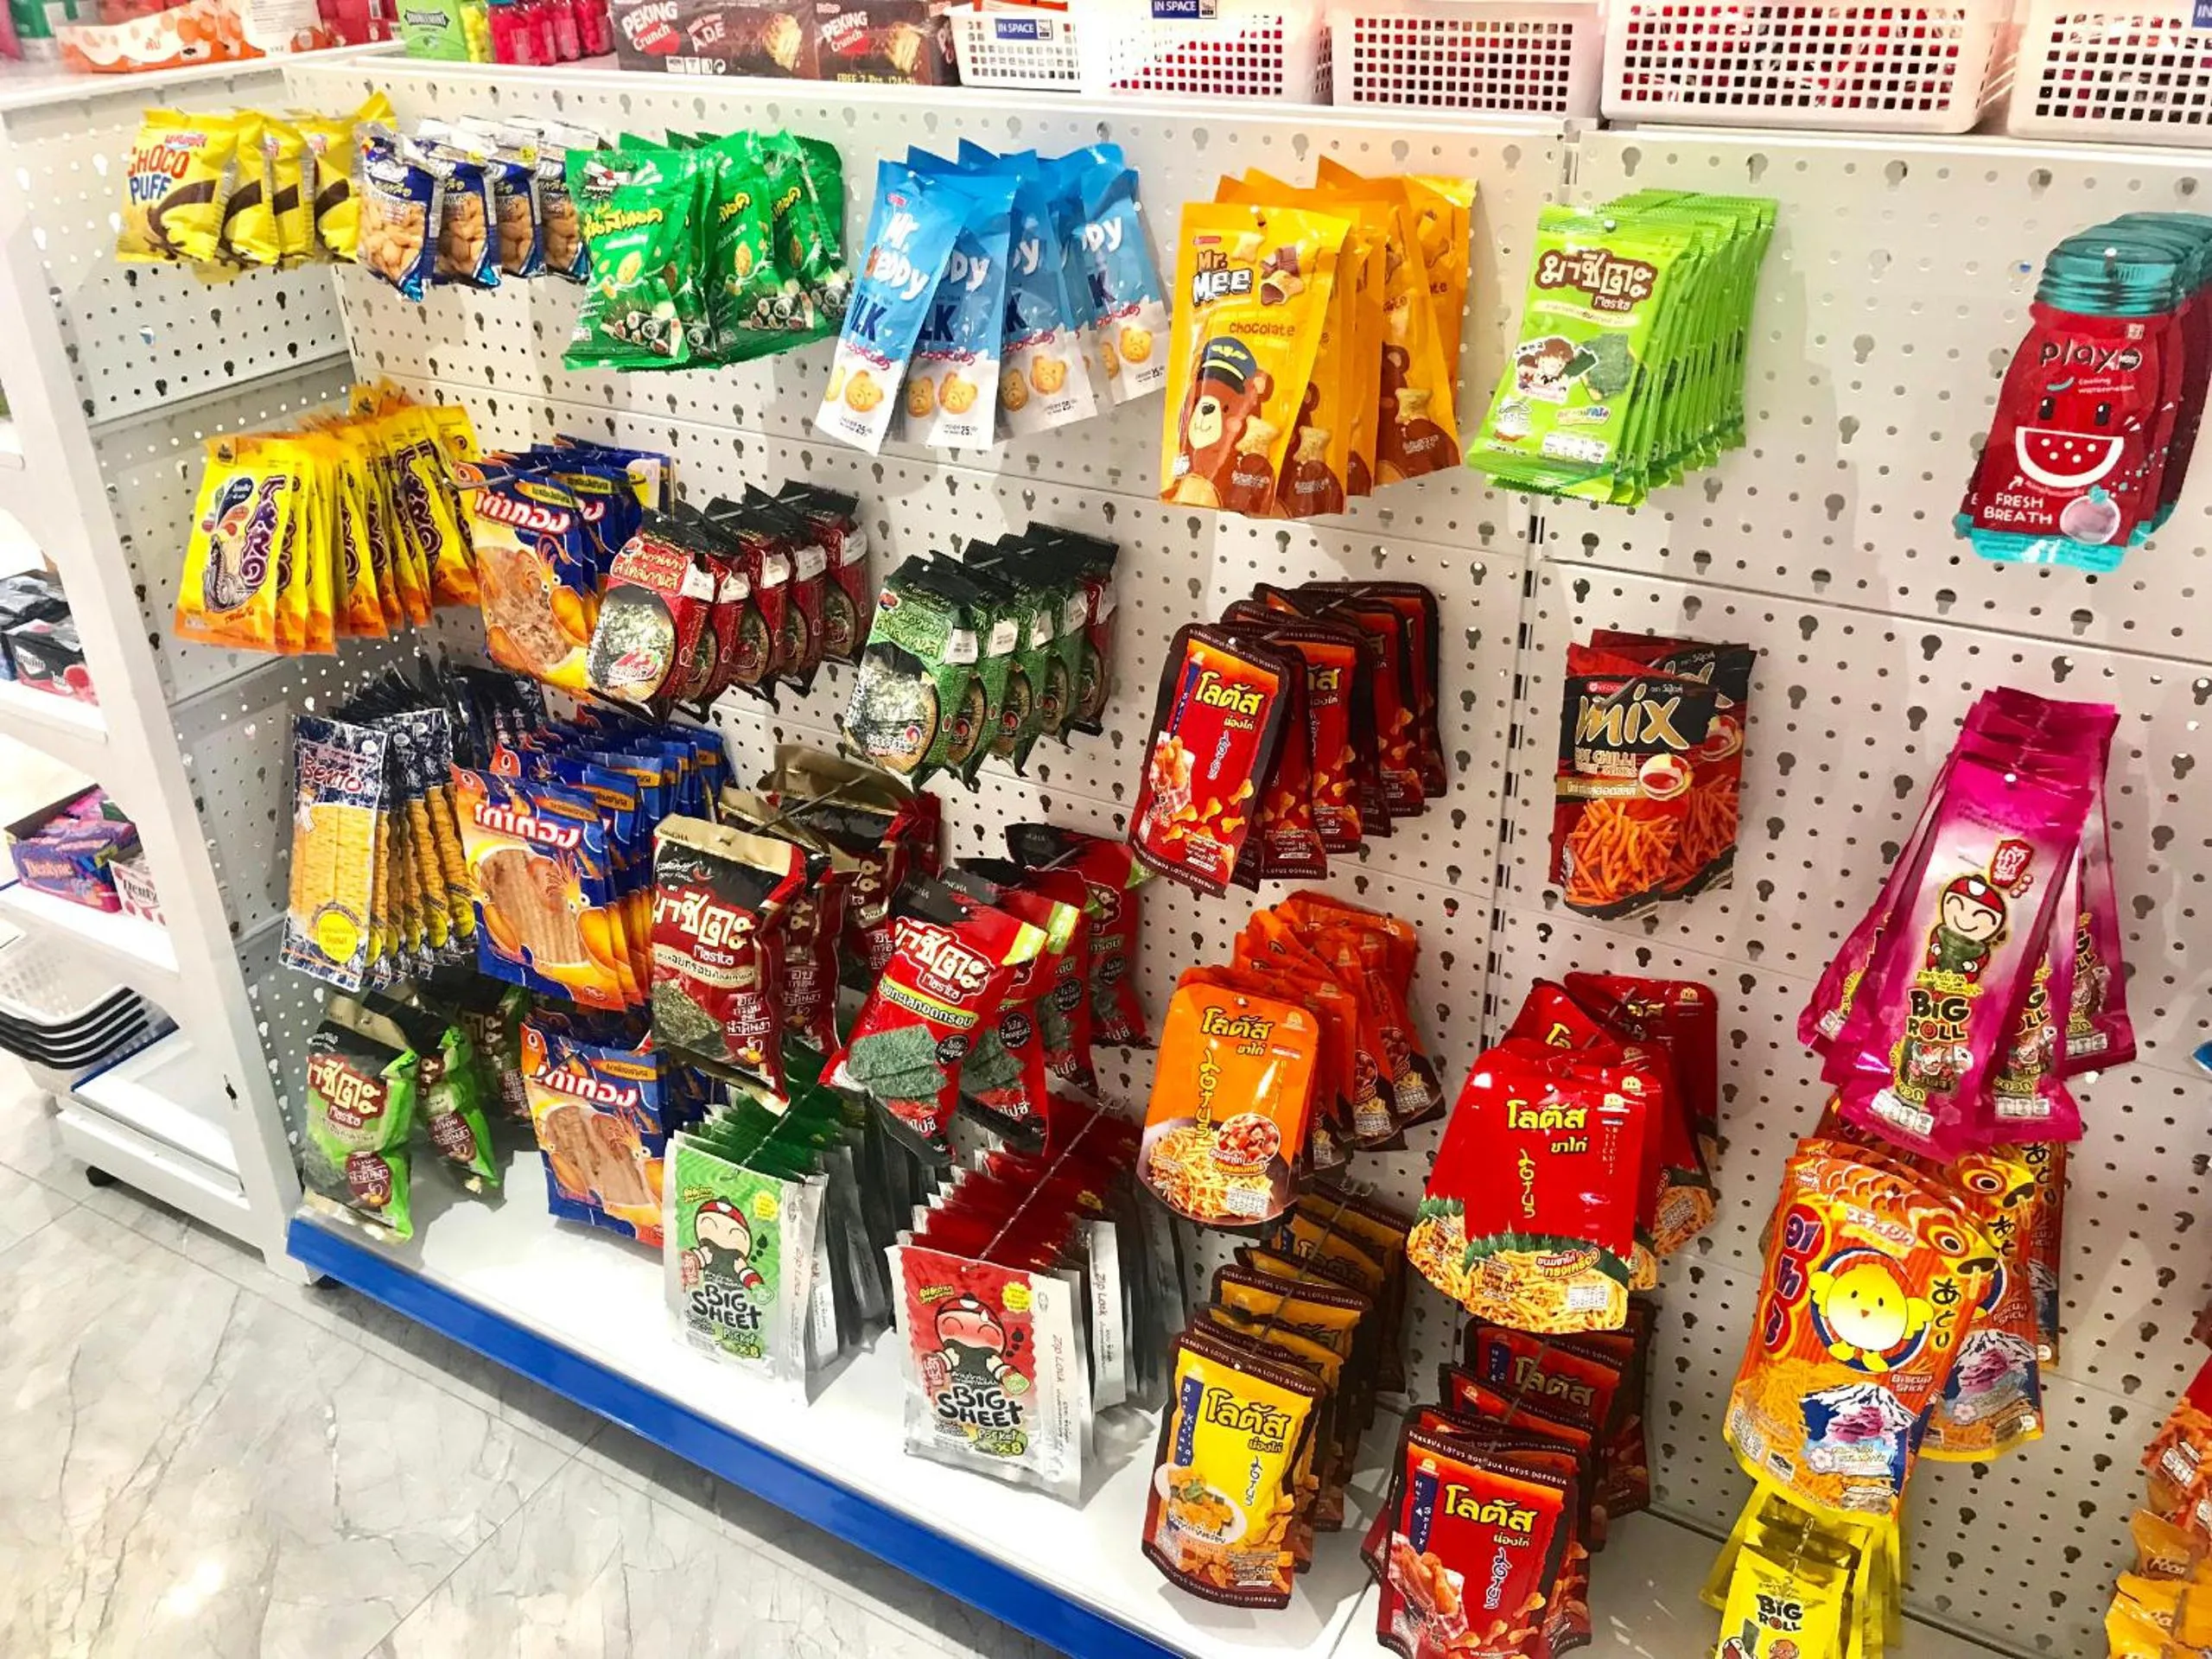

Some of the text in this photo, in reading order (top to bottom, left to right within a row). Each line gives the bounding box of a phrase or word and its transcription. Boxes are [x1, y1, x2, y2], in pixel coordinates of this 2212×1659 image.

[1168, 1, 1197, 11] SPACE
[621, 3, 678, 40] PEKING
[822, 11, 868, 42] PEKING
[997, 23, 1034, 34] IN SPACE
[632, 23, 671, 52] Crunch
[130, 174, 172, 206] PUFF
[1197, 249, 1228, 272] Mr.
[1984, 506, 2053, 524] BREATH
[1995, 493, 2044, 508] FRESH
[1196, 671, 1264, 716] โลตัส
[1908, 988, 1970, 1023] BIG
[1200, 1006, 1275, 1041] โลตัส
[1908, 1017, 1968, 1041] ROLL
[1506, 1097, 1588, 1131] โลตัส
[1551, 1136, 1588, 1154] ขาไก่
[704, 1284, 748, 1313] BIG
[1930, 1277, 1961, 1349] あとり
[953, 1385, 1006, 1411] BIG
[1205, 1386, 1289, 1440] โลตัส
[1445, 1484, 1538, 1534] โลตัส
[1756, 1594, 1803, 1621] BIG
[1758, 1612, 1802, 1631] ROLL
